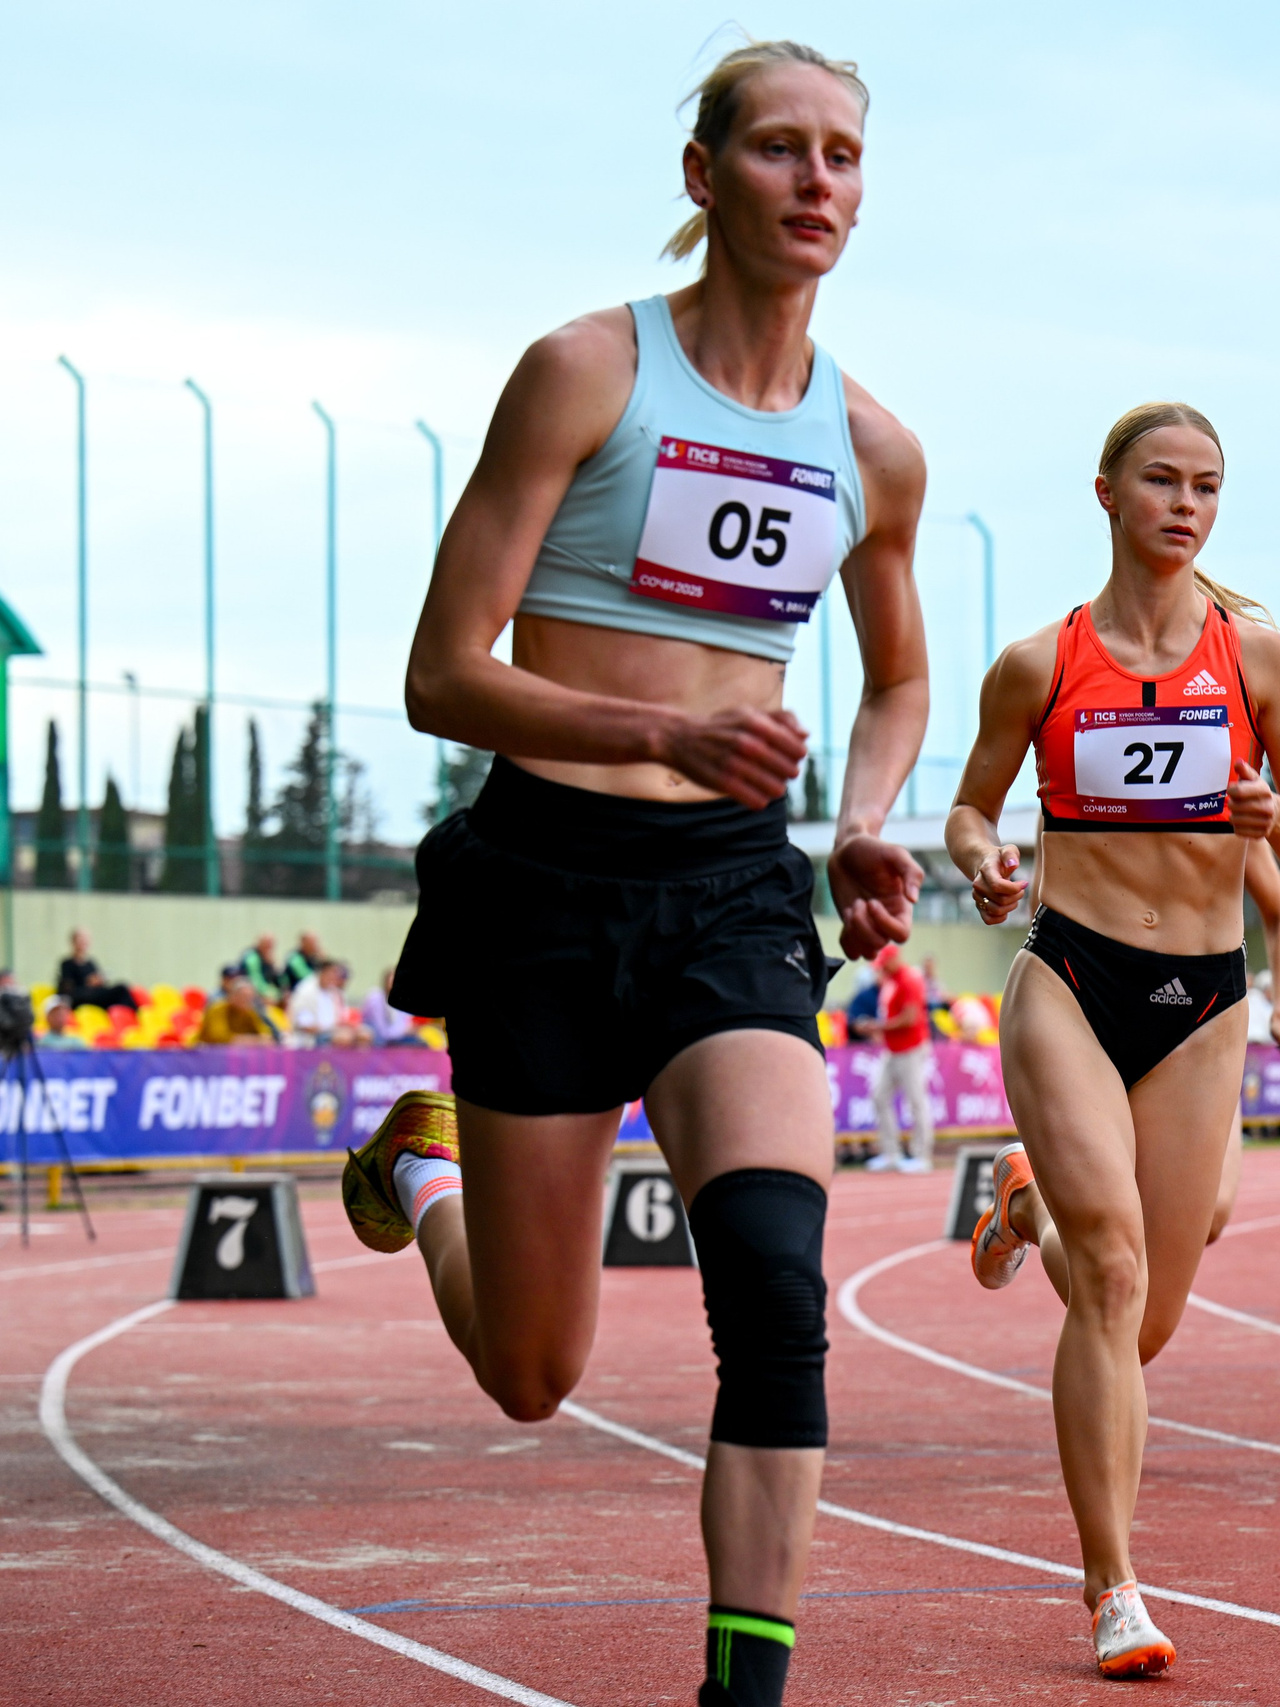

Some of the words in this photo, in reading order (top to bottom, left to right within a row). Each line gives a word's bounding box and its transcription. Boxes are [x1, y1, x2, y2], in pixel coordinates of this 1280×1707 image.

[687, 445, 720, 465] ПСБ
[789, 467, 833, 489] FONBET
[708, 501, 792, 567] 05
[1183, 685, 1227, 696] adidas
[1094, 712, 1117, 721] ПСБ
[1179, 709, 1223, 720] FONBET
[1123, 741, 1185, 785] 27
[1083, 804, 1106, 813] СОЧИ
[1107, 804, 1127, 813] 2025
[1198, 800, 1218, 810] ВФЛА
[1149, 993, 1193, 1005] adidas
[0, 1077, 117, 1133] NBET
[138, 1075, 286, 1130] FONBET
[626, 1178, 676, 1242] 6
[209, 1195, 258, 1269] 7
